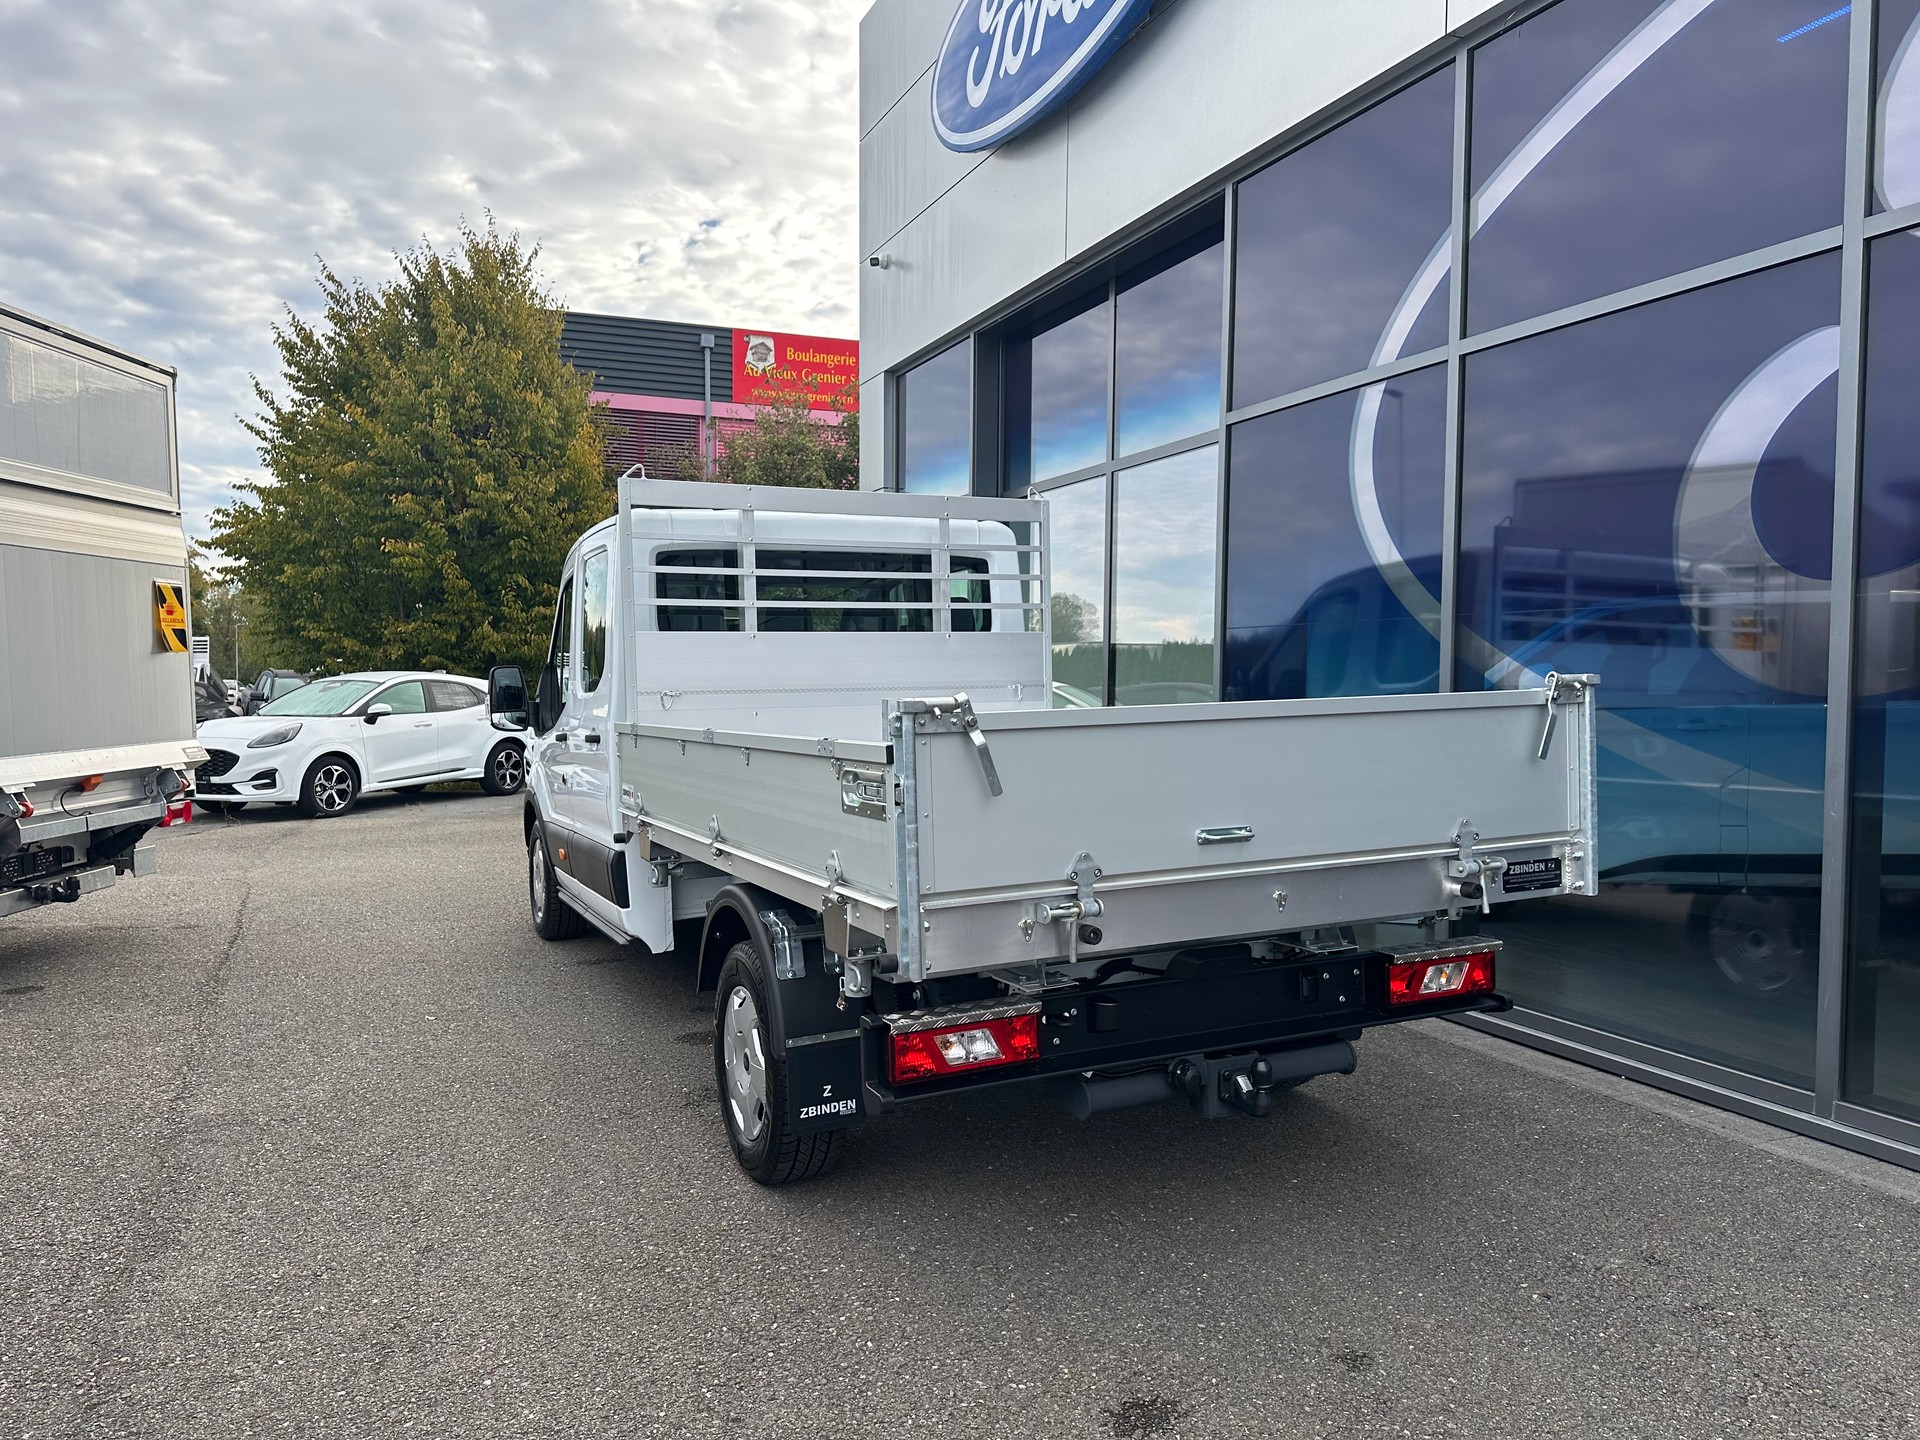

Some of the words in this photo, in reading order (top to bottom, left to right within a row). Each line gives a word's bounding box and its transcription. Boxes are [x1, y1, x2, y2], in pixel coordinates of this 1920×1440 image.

[786, 347, 856, 368] Boulangerie
[743, 365, 760, 377] Au
[1509, 862, 1546, 875] ZBINDEN
[822, 1085, 832, 1097] Z
[799, 1099, 856, 1119] ZBINDEN
